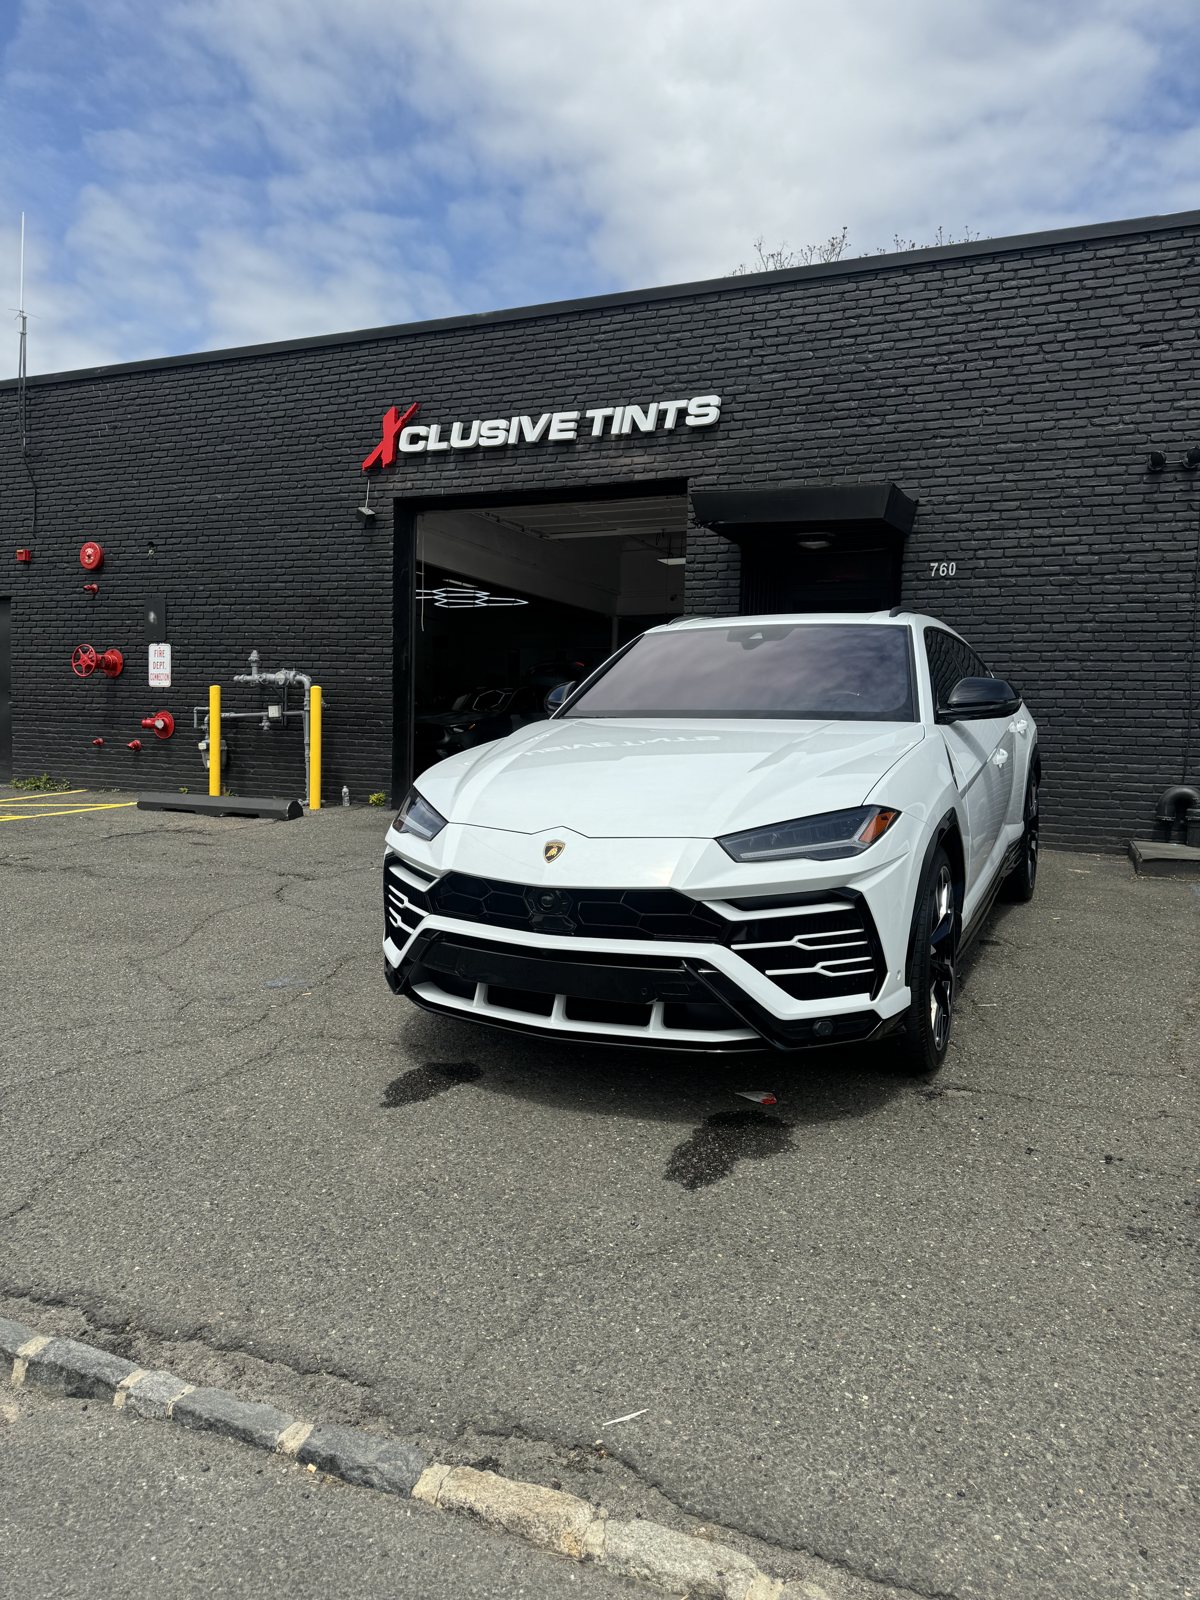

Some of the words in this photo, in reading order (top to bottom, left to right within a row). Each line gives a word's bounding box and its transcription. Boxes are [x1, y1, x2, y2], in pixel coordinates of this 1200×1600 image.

[586, 395, 722, 437] TINTS
[929, 561, 957, 577] 760
[154, 649, 165, 658] FIRE
